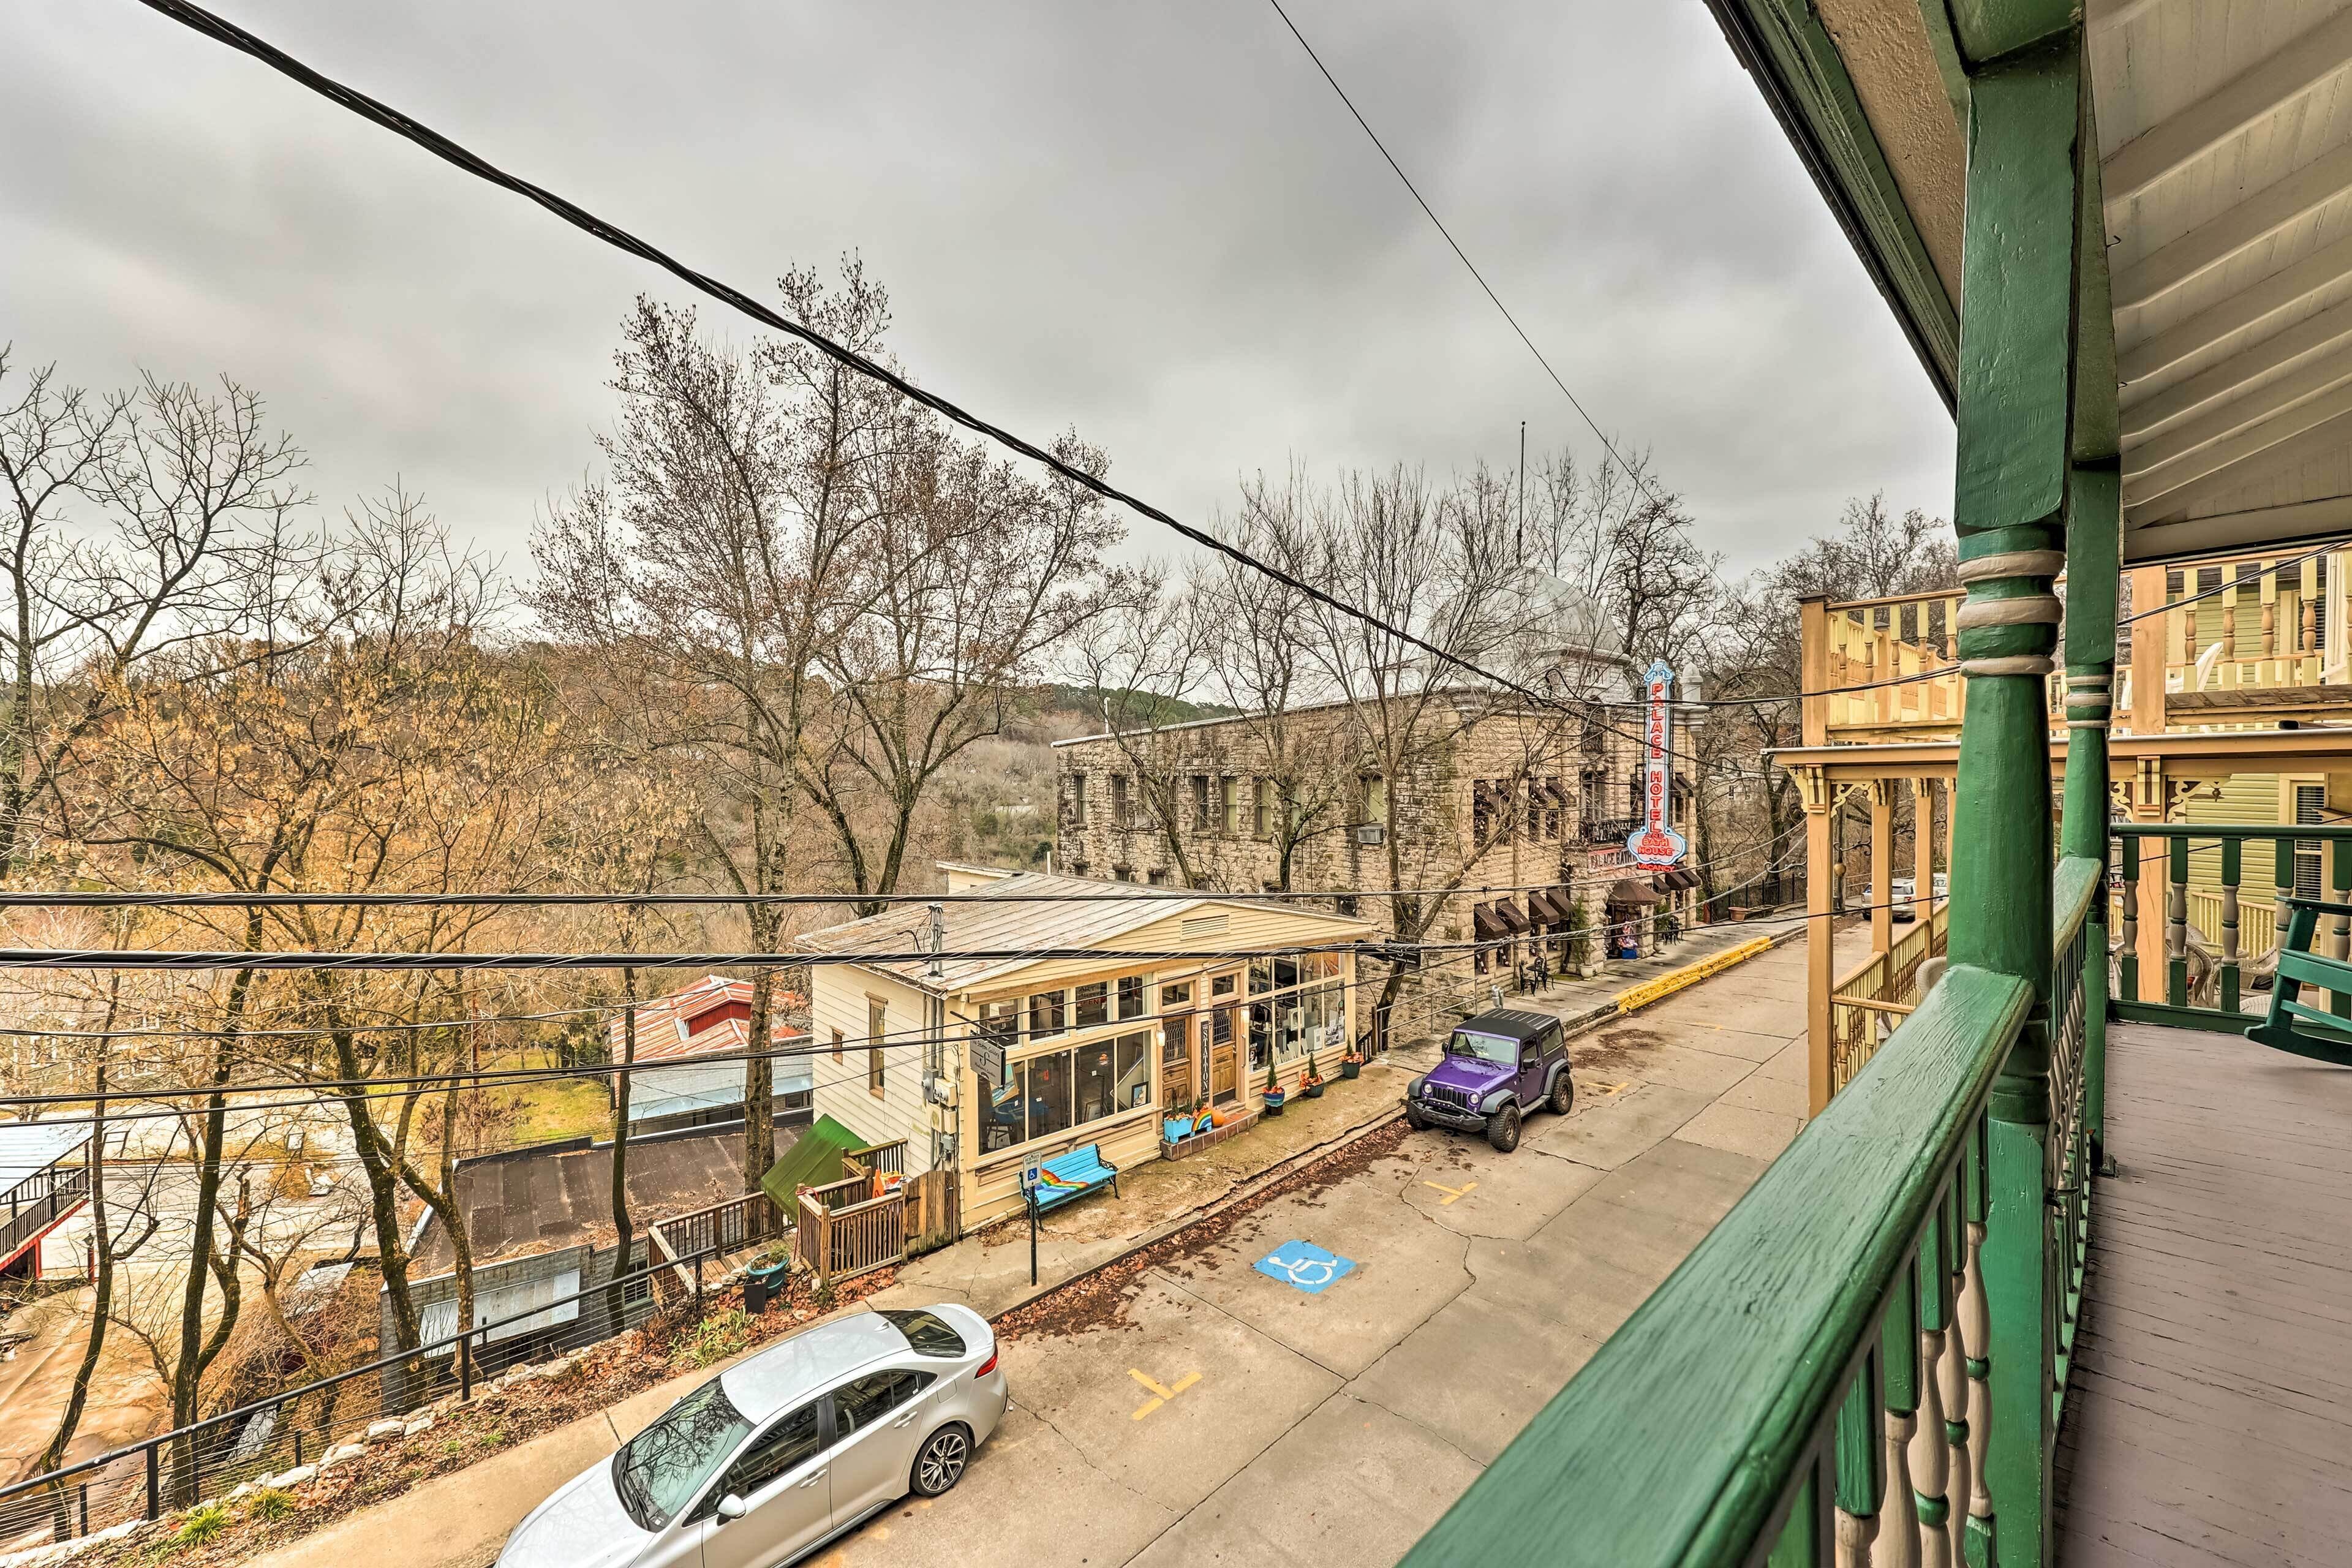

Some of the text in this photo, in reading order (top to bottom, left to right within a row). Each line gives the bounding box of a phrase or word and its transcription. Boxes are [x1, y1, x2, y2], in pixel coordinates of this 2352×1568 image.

[1650, 683, 1664, 832] PALACE HOTEL
[1642, 838, 1669, 846] BATH
[1638, 845, 1673, 856] HOUSE
[1637, 862, 1675, 872] VACANCY
